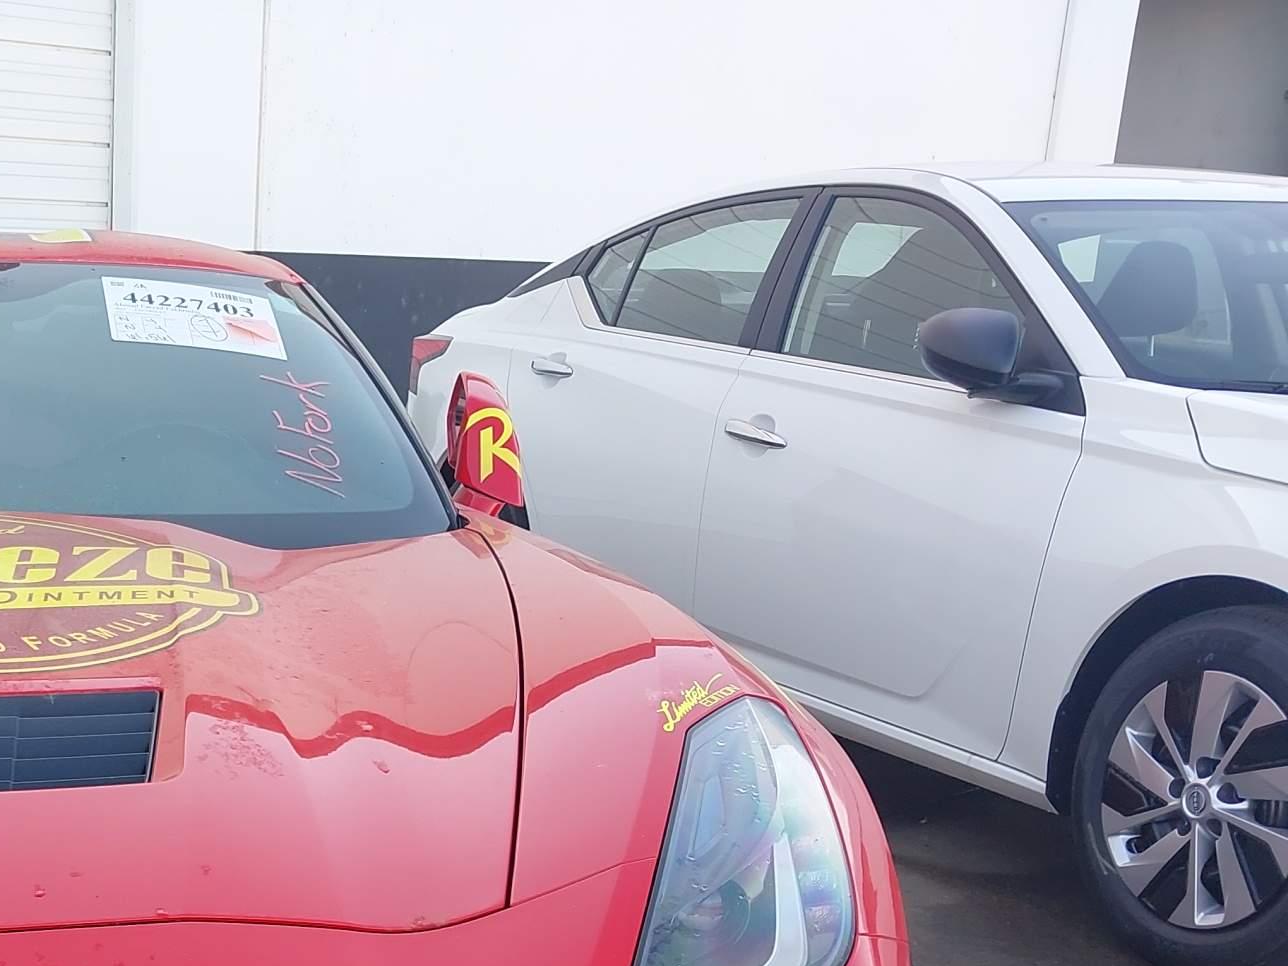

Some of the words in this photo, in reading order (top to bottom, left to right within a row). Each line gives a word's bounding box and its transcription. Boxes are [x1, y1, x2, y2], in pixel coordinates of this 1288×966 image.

[122, 292, 255, 319] 44227403
[465, 407, 522, 483] R
[20, 611, 165, 651] FORMULA
[656, 673, 722, 732] Limited
